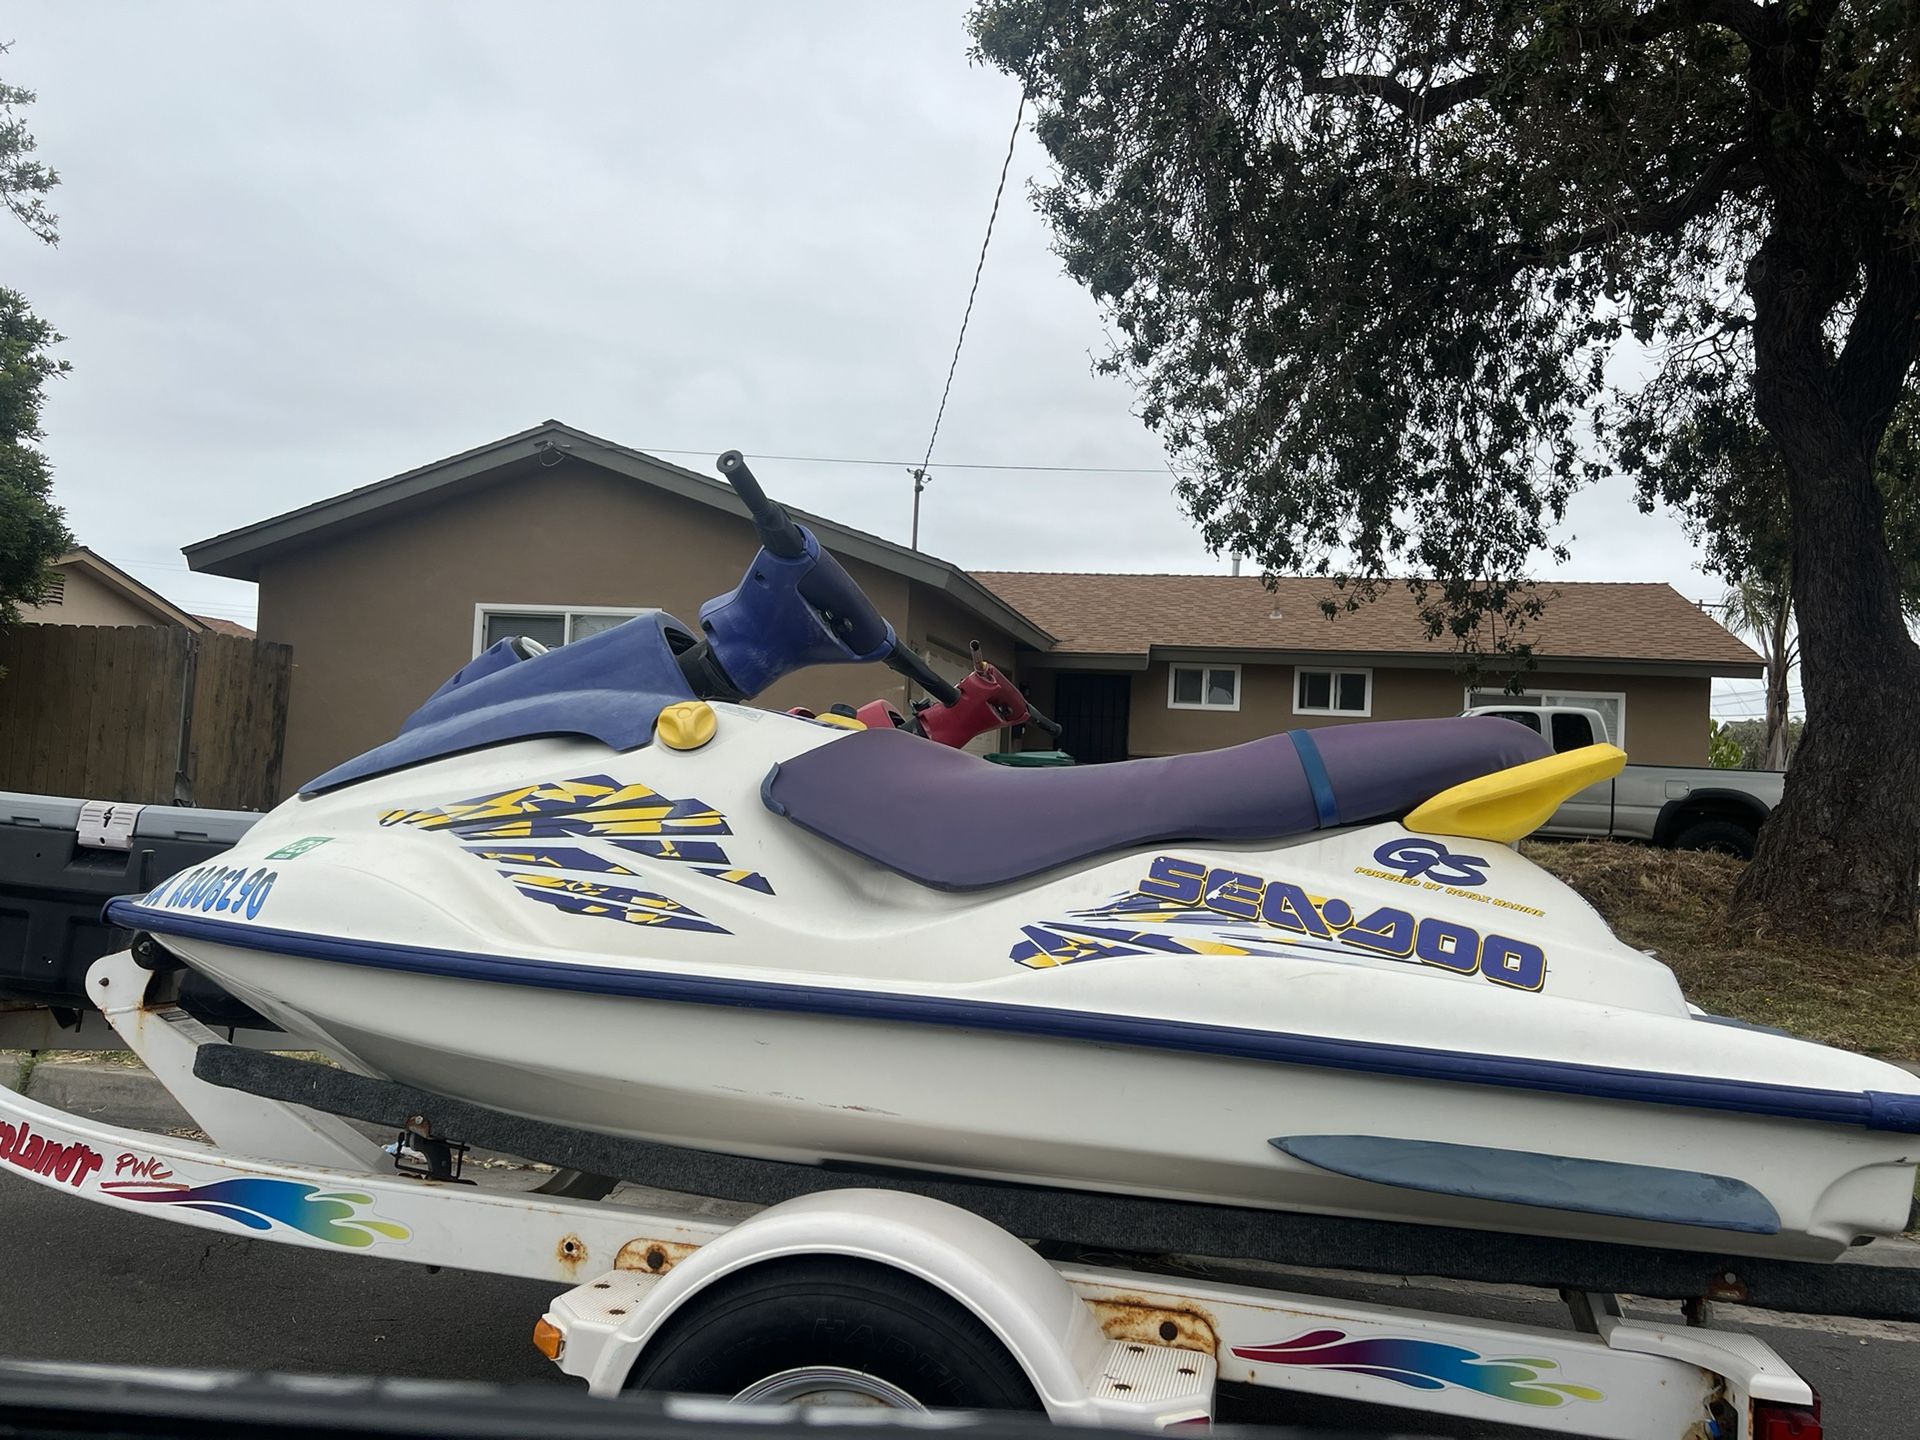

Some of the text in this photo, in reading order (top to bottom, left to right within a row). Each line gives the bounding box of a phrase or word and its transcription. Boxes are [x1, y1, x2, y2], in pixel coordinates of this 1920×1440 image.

[1373, 837, 1491, 886] GS
[1353, 866, 1546, 917] POWERED BY ROTAX MARINE
[115, 1152, 173, 1180] PWC
